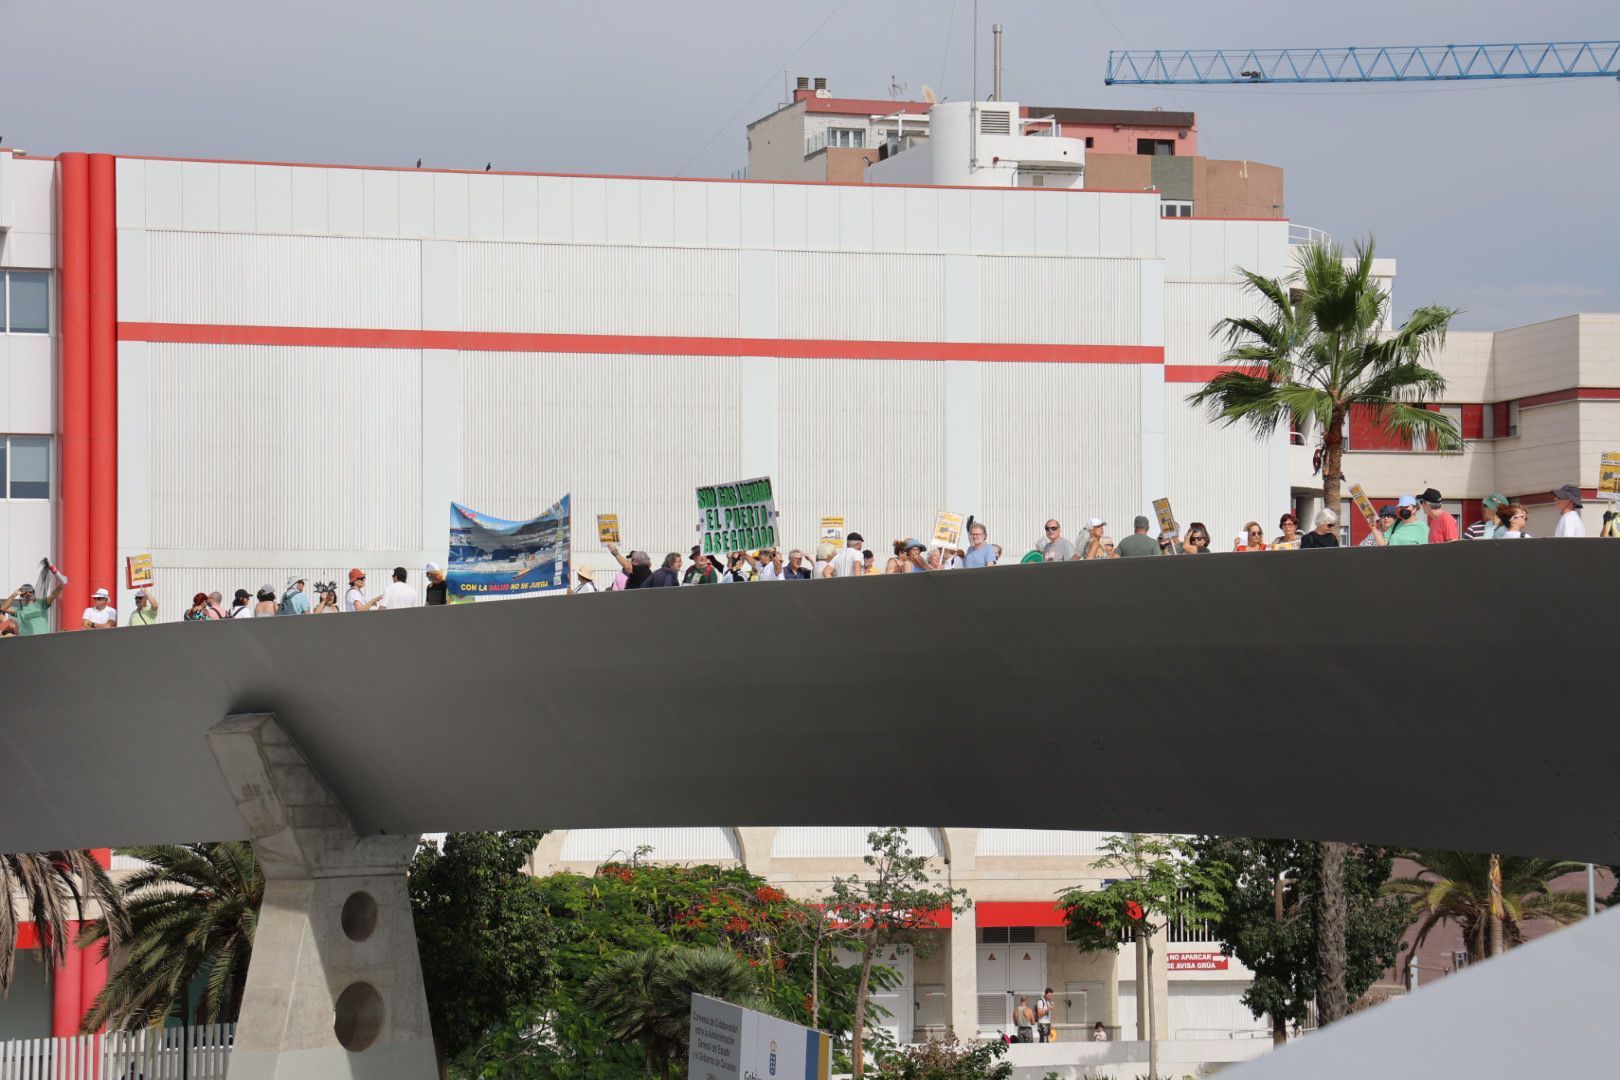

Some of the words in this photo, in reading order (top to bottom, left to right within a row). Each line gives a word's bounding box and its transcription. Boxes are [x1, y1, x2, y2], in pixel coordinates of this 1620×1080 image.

[717, 485, 737, 507] GAS
[706, 508, 721, 530] EL
[725, 504, 768, 529] PUERTO
[704, 525, 775, 553] ASEGURADO
[460, 583, 477, 591] CON
[530, 580, 549, 589] JUEGA
[1180, 953, 1212, 961] APARCAR
[1196, 960, 1216, 969] GRÚA
